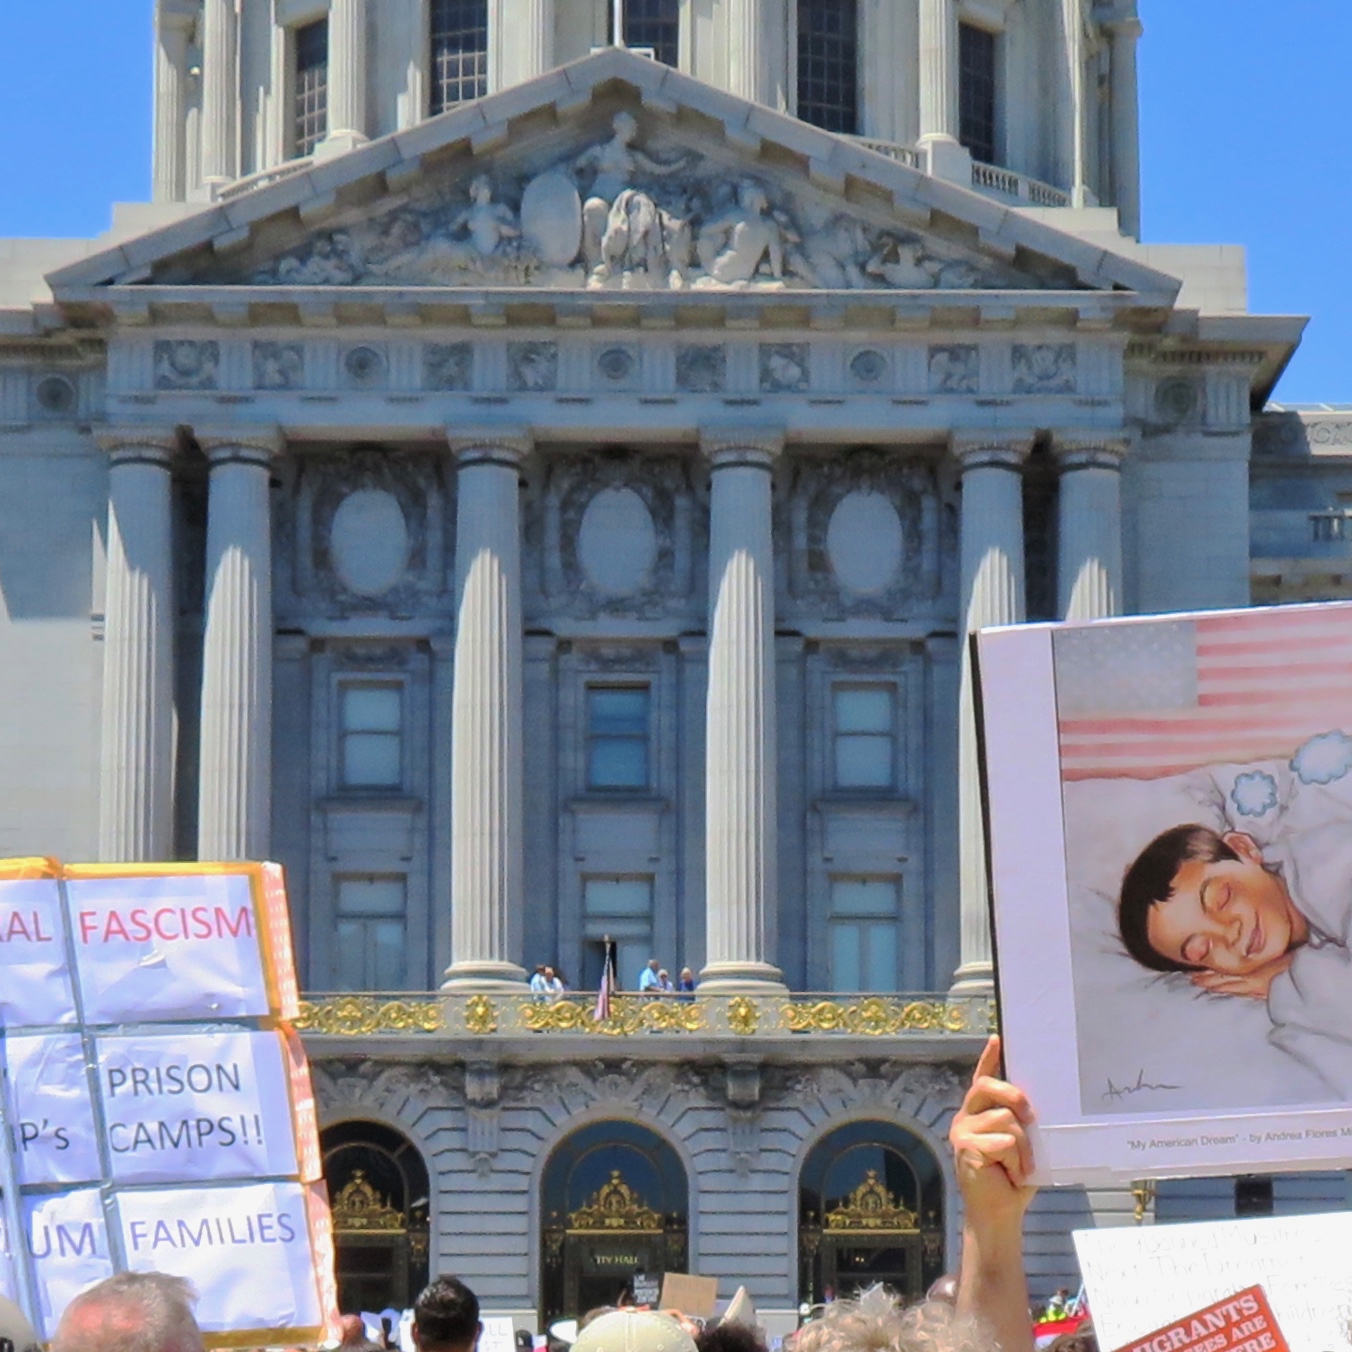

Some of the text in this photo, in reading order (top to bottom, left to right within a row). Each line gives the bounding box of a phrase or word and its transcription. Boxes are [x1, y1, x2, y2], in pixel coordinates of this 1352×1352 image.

[79, 906, 253, 945] FASCISM
[108, 1063, 242, 1098] PRISON
[109, 1113, 263, 1153] CAMPS!!
[1149, 1136, 1198, 1149] American
[1249, 1133, 1262, 1144] by
[1264, 1130, 1303, 1142] Andrea
[1305, 1128, 1338, 1139] Flores
[130, 1212, 296, 1252] FAMILIES
[1231, 1315, 1268, 1343] ARE
